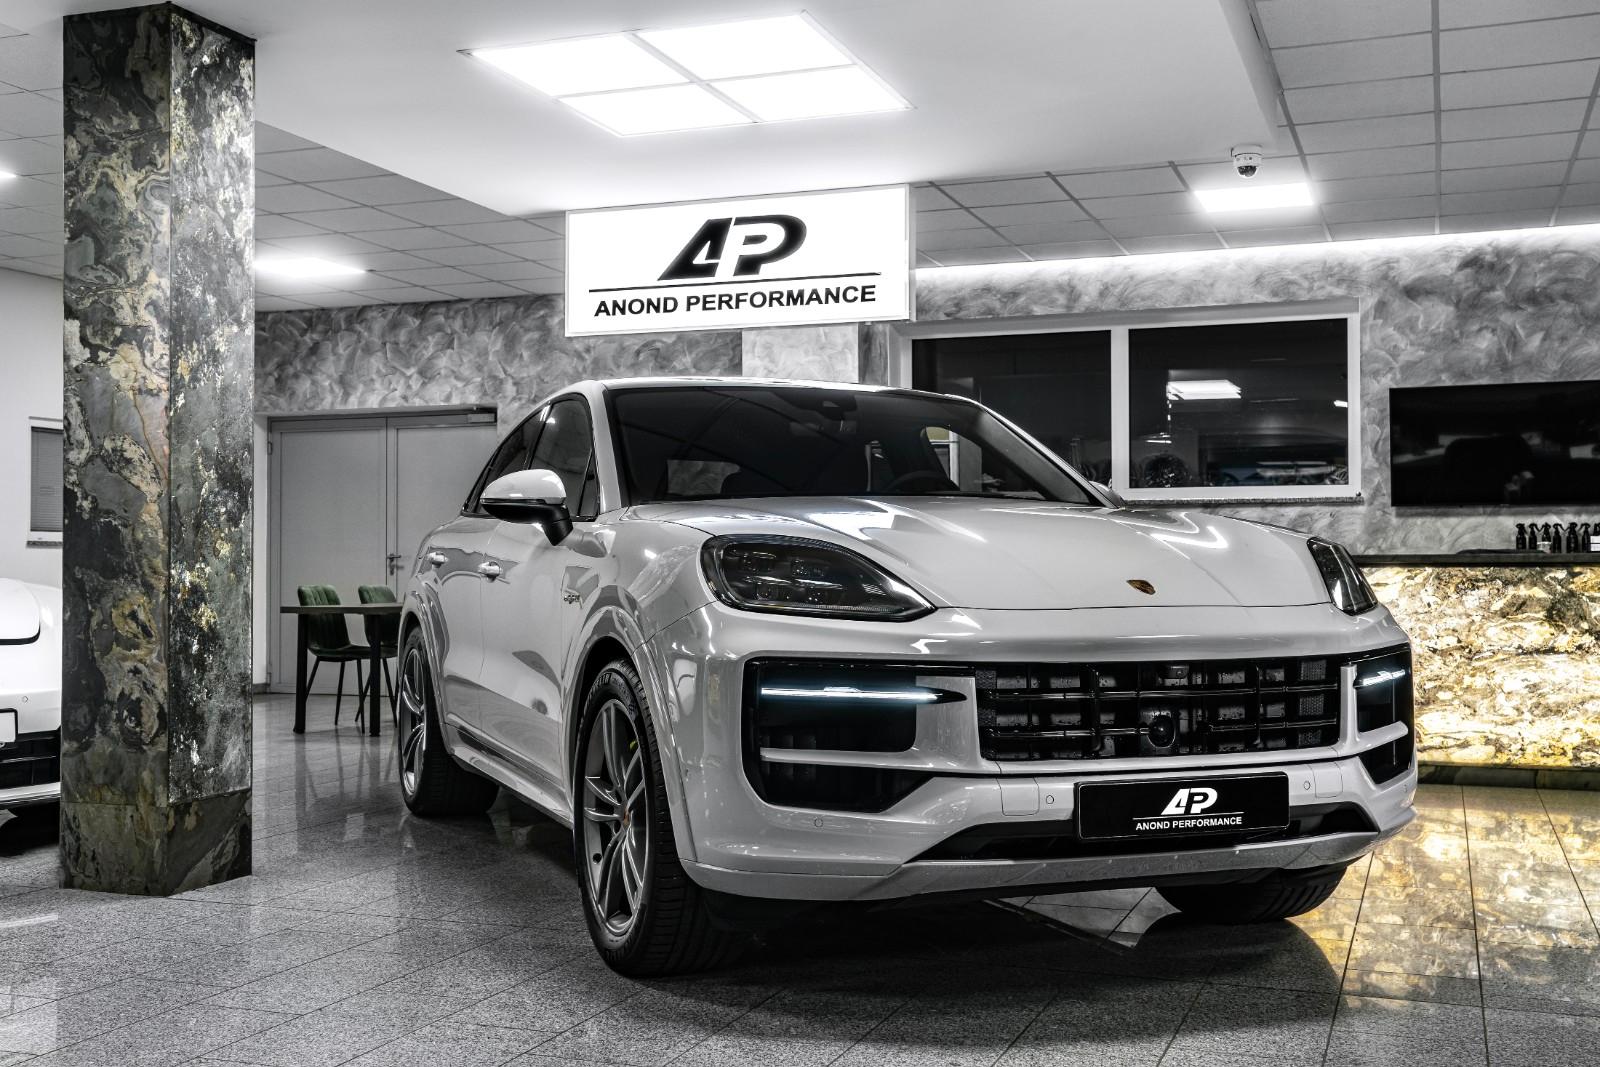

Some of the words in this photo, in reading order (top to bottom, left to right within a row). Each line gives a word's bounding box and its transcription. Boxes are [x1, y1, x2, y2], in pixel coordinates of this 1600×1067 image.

[657, 214, 807, 281] AP
[594, 297, 678, 317] ANOND
[686, 284, 877, 312] PERFORMANCE
[1160, 787, 1218, 815] AP
[1135, 820, 1170, 831] ANOND
[1172, 816, 1242, 829] PERFORMANCE
